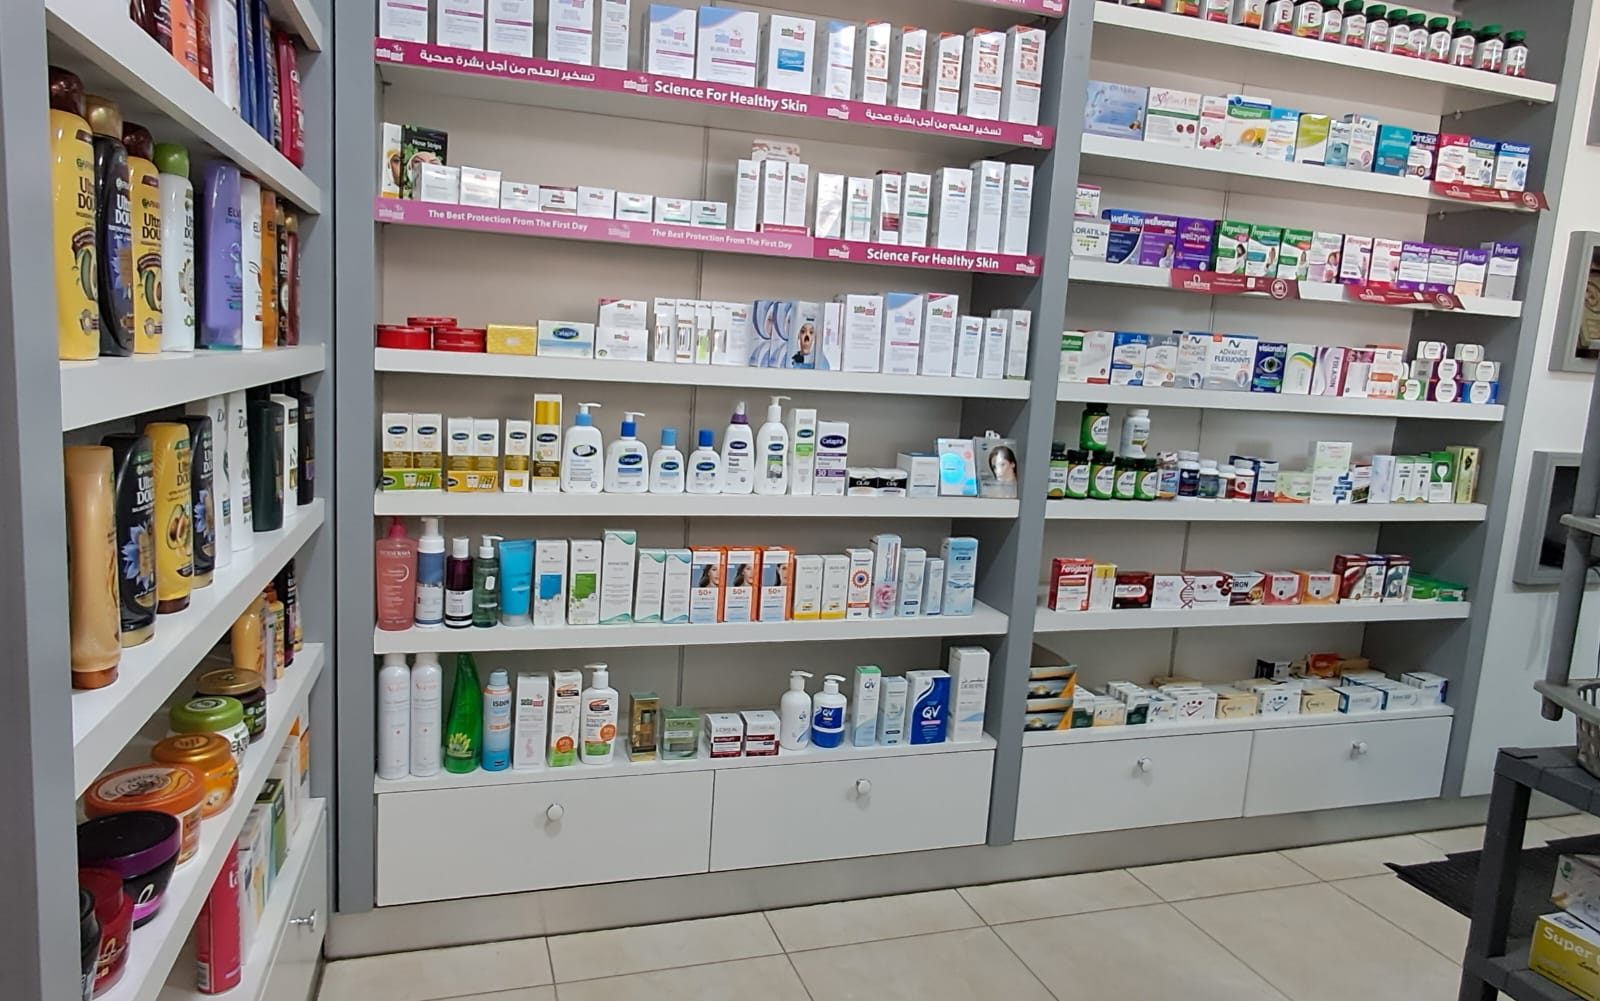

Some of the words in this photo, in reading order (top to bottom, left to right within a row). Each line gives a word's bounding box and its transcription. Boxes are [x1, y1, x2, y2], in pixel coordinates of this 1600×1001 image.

[1281, 10, 1288, 20] E
[1307, 12, 1315, 23] E
[419, 49, 454, 64] صحية
[456, 55, 484, 71] بشرة
[485, 60, 508, 72] أجل
[509, 63, 526, 75] من
[527, 66, 559, 78] العلم
[561, 71, 595, 83] تسخير
[654, 80, 704, 98] Science
[706, 88, 727, 102] For
[729, 92, 778, 112] Healthy
[781, 98, 808, 112] Skin
[866, 108, 892, 121] صحية
[893, 114, 916, 126] بشرة
[916, 116, 934, 127] أجل
[934, 120, 948, 130] من
[948, 122, 974, 133] العلم
[974, 126, 1002, 136] تسخير
[428, 209, 445, 219] The
[446, 211, 465, 220] Best
[466, 213, 511, 225] Protection
[512, 217, 534, 227] From
[536, 218, 551, 228] The
[552, 221, 571, 230] First
[572, 222, 588, 233] Day
[651, 228, 667, 238] The
[667, 230, 684, 240] Best
[685, 232, 725, 243] Protection
[725, 235, 746, 245] From
[746, 236, 760, 246] The
[761, 238, 777, 247] First
[778, 240, 793, 250] Day
[867, 248, 909, 262] Science
[911, 251, 930, 263] For
[931, 254, 975, 270] Healthy
[976, 256, 999, 269] Skin
[821, 436, 844, 446] Cetaphil
[1232, 580, 1249, 588] IRON
[698, 588, 712, 596] 50+
[864, 681, 877, 689] QV
[821, 709, 835, 717] QV
[922, 706, 941, 720] QV
[1543, 926, 1593, 959] Super
